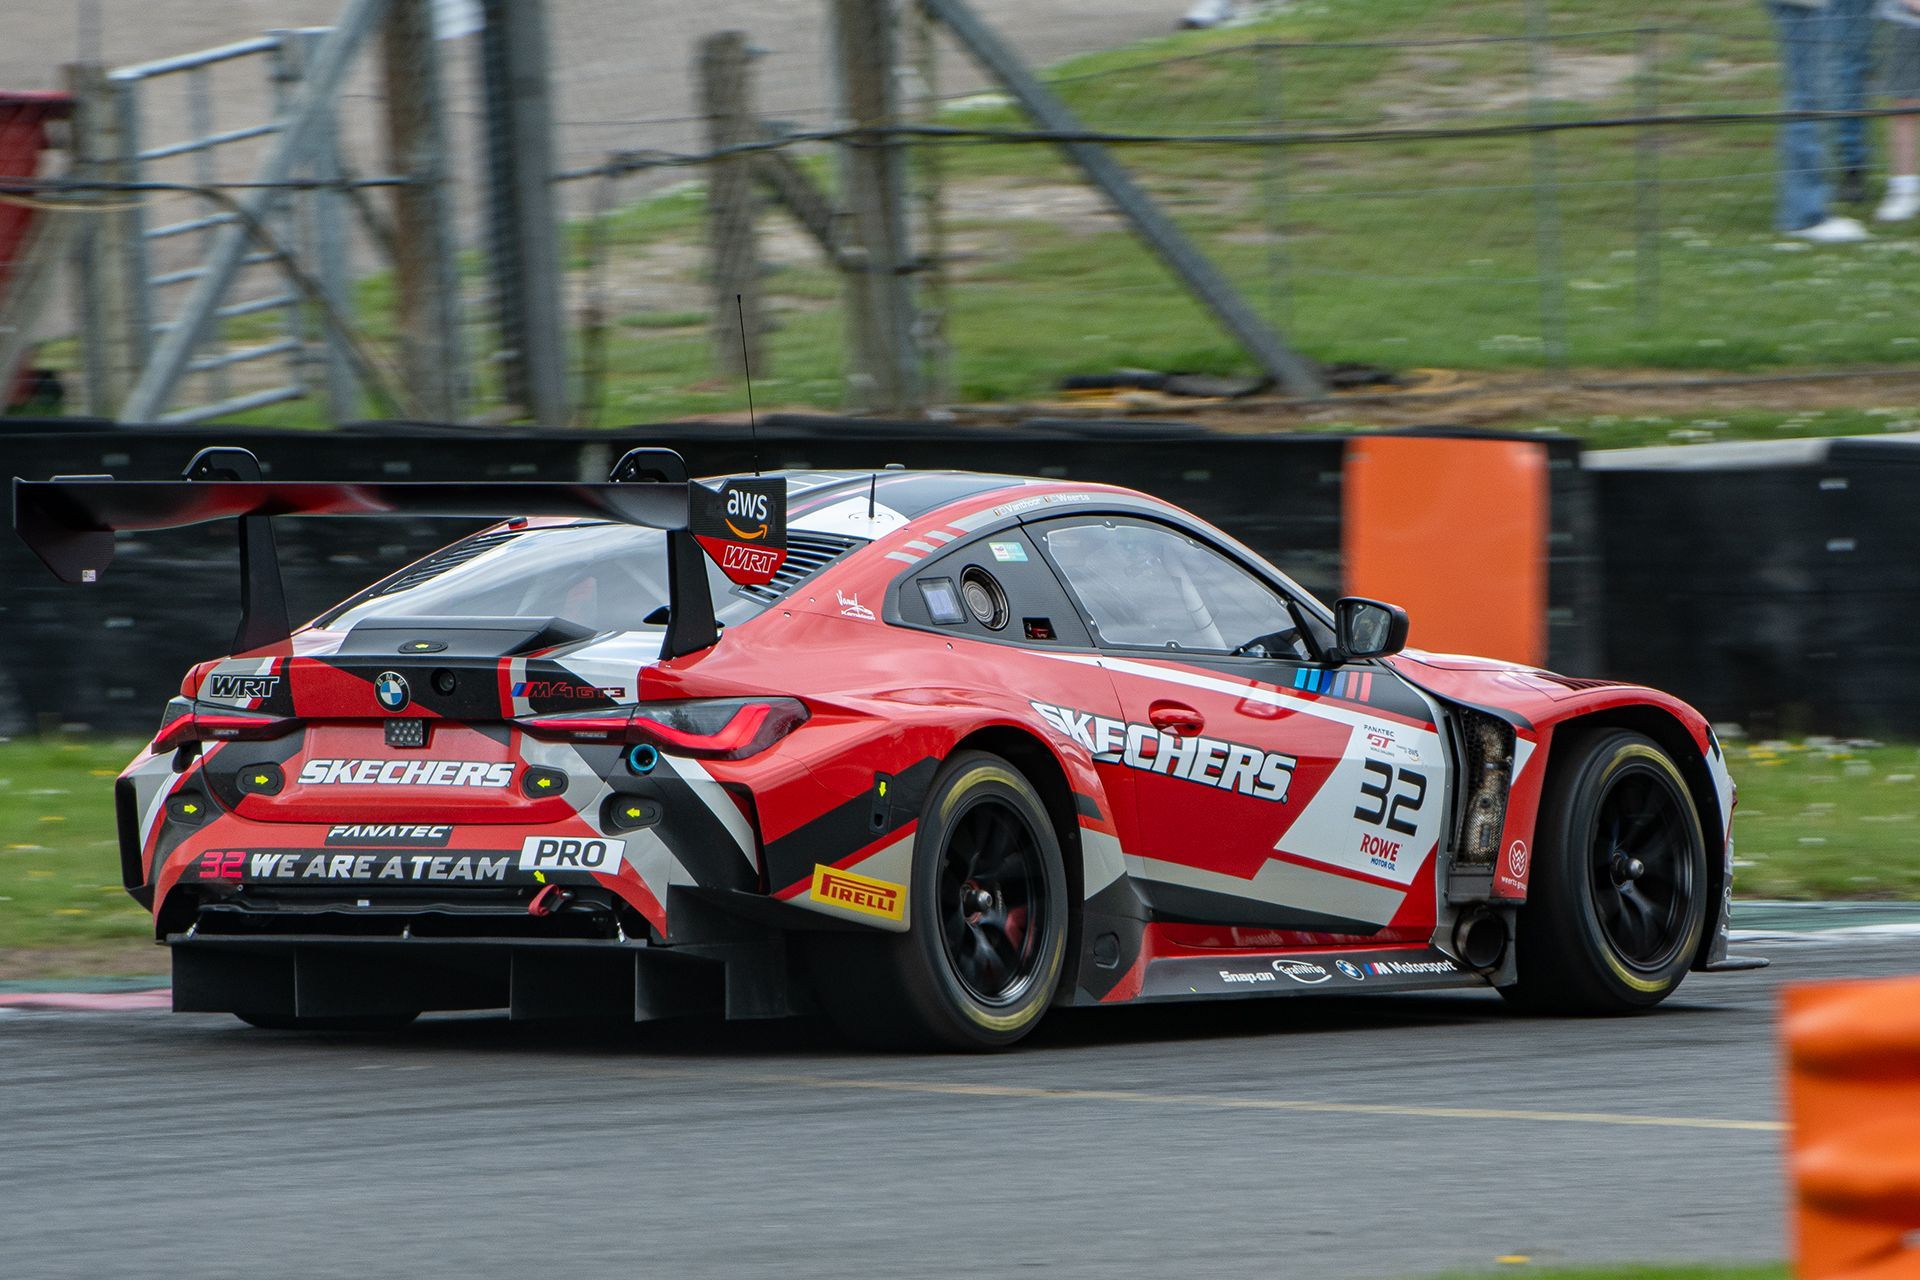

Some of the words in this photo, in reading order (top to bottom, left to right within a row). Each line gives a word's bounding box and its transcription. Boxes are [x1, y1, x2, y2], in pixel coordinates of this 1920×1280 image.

[727, 489, 768, 521] aws
[723, 545, 778, 575] WRT
[210, 675, 280, 699] WRT
[525, 680, 574, 698] M4
[577, 686, 626, 698] GT3
[1363, 724, 1395, 738] FANATEC
[1367, 733, 1396, 749] GT
[1028, 700, 1299, 805] SKECHERS
[296, 758, 517, 788] SKECHERS
[1353, 757, 1427, 837] 32
[328, 825, 452, 838] FANATEC
[533, 839, 608, 868] PRO
[1360, 832, 1401, 862] ROWE
[199, 851, 247, 879] 32
[250, 853, 301, 878] WE
[302, 854, 378, 879] ARE
[410, 856, 511, 881] TEAM
[1370, 857, 1388, 870] MOTOR
[820, 873, 897, 912] PIRELLI
[1374, 961, 1393, 975] M
[1387, 959, 1458, 974] Motorsport
